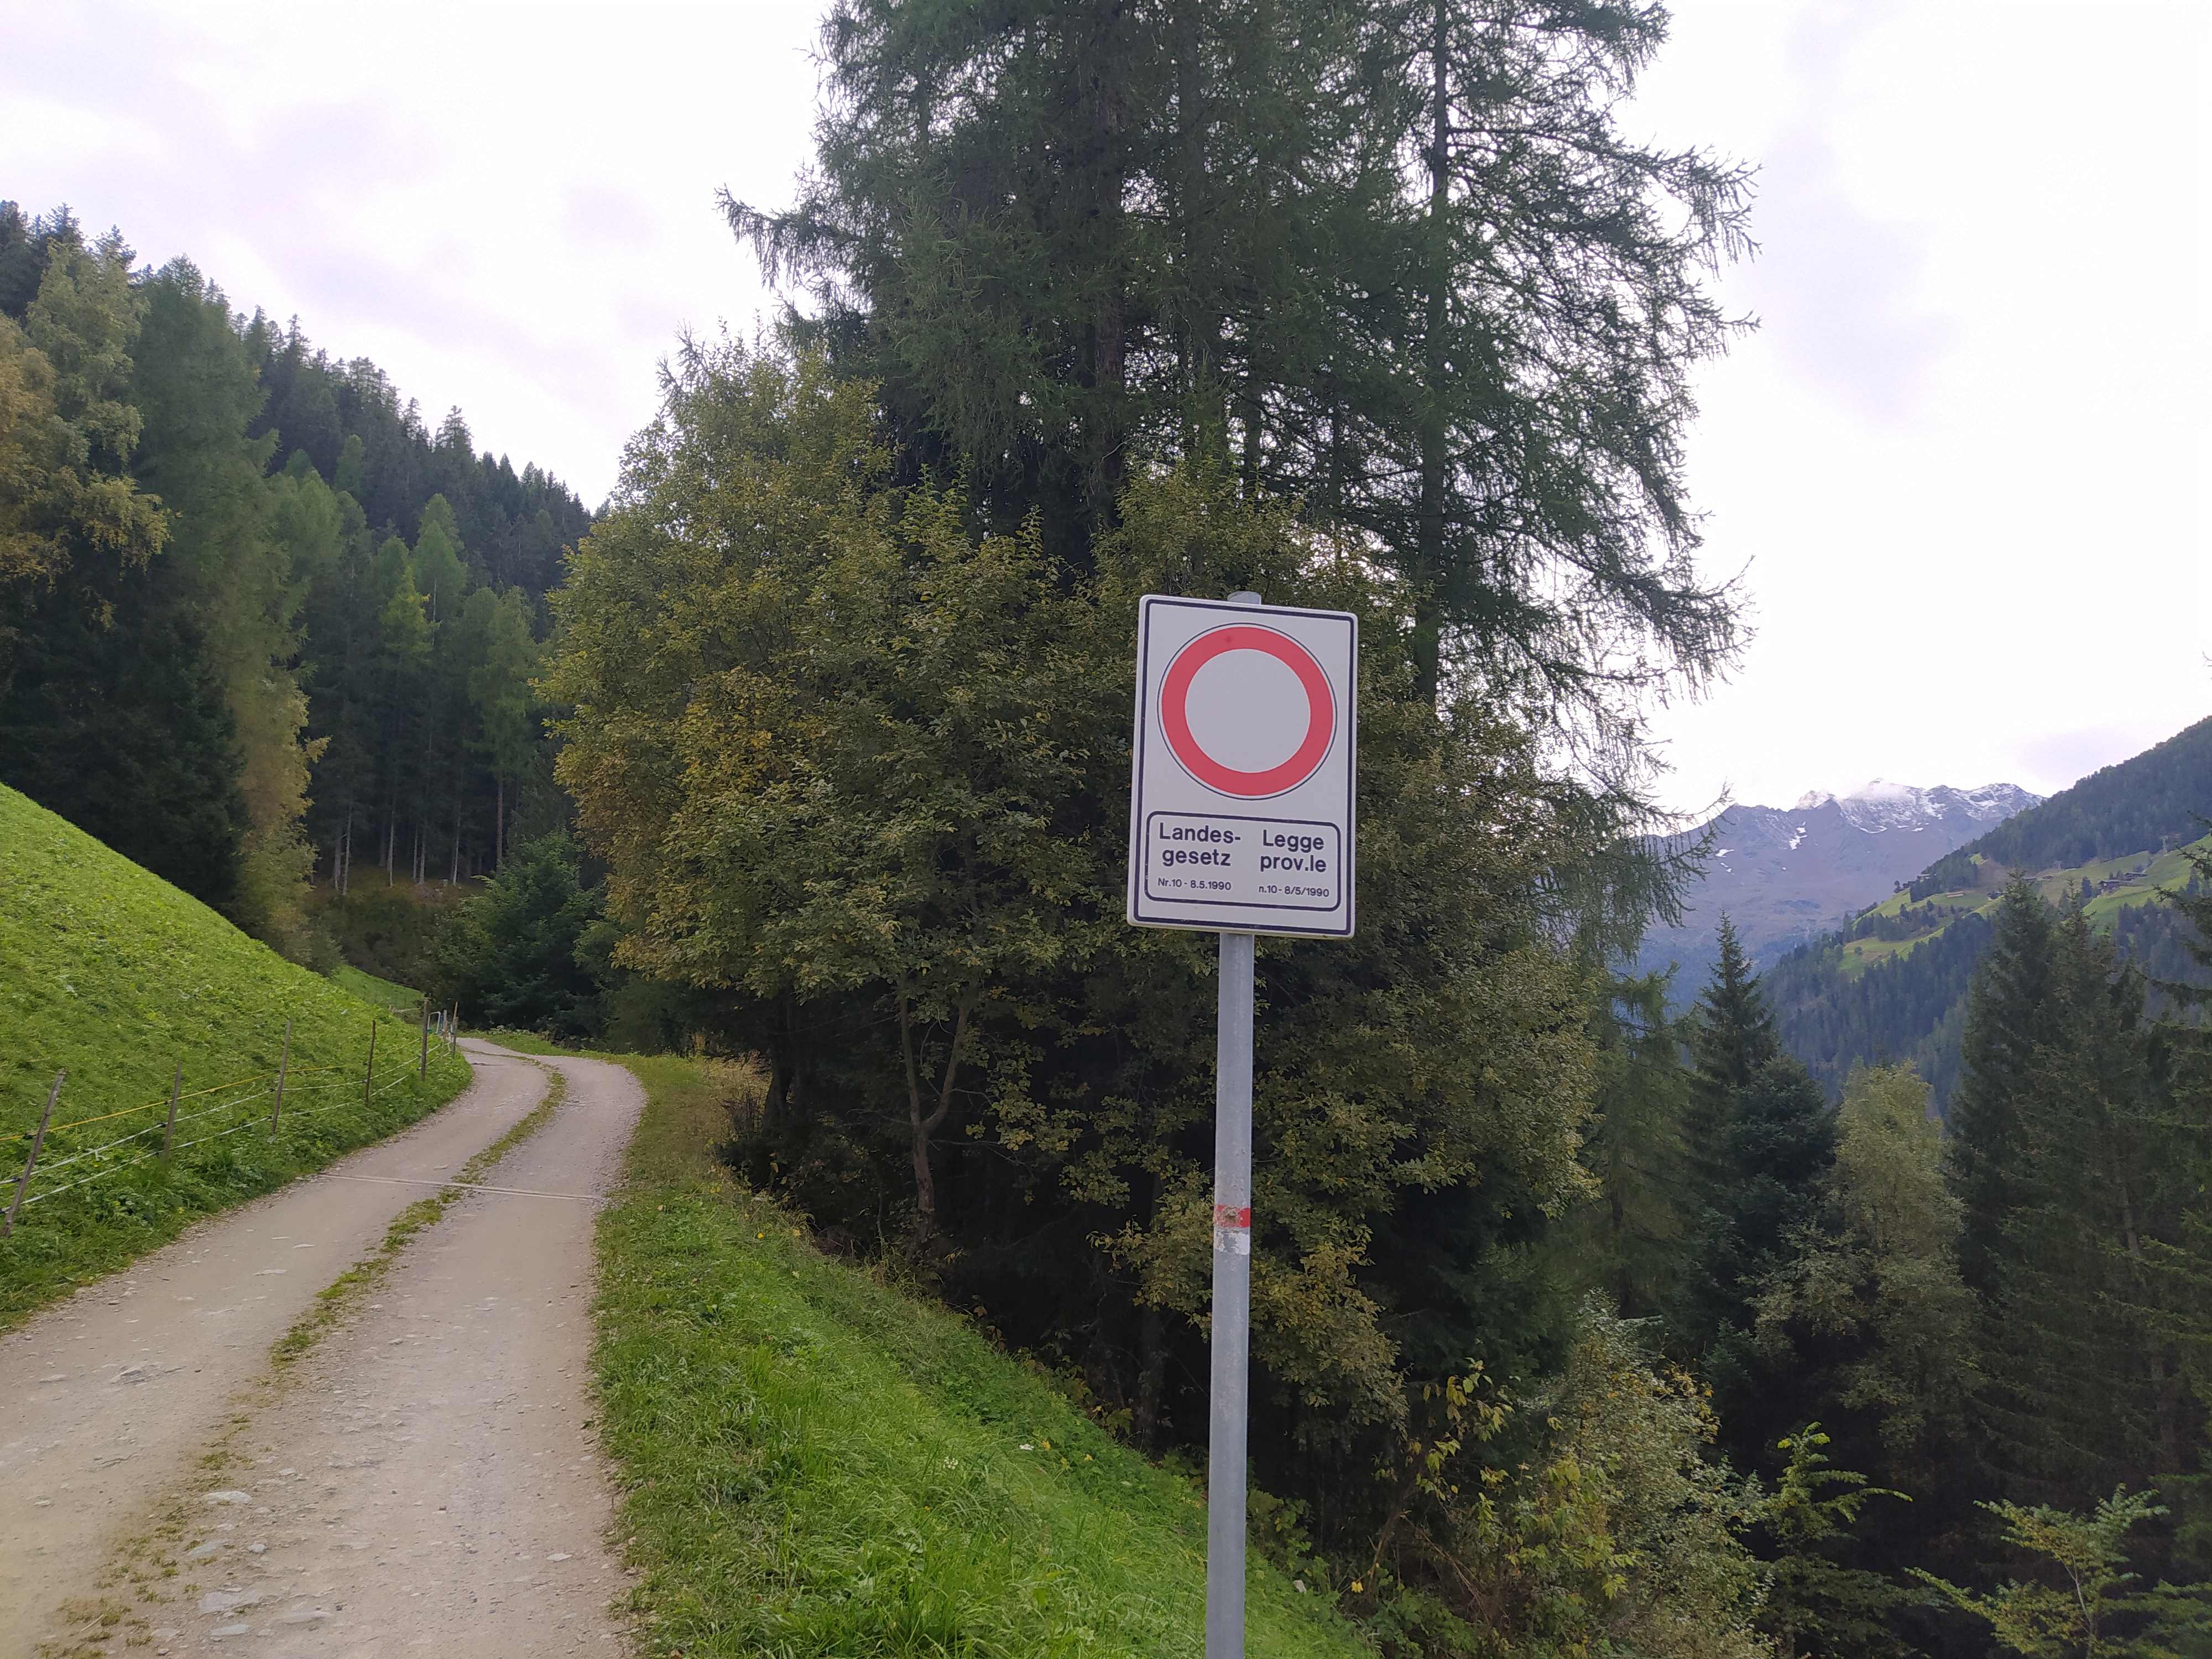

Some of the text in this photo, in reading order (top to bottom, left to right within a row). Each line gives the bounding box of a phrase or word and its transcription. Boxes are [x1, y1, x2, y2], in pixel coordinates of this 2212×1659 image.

[1160, 822, 1241, 844] Landes-
[1262, 830, 1324, 853] Legge
[1162, 849, 1231, 867] gesetz
[1260, 855, 1327, 872] prov.le
[1157, 878, 1182, 888] Nr.10
[1191, 880, 1231, 890] 8.5.1990
[1284, 886, 1330, 897] 8/5/1990
